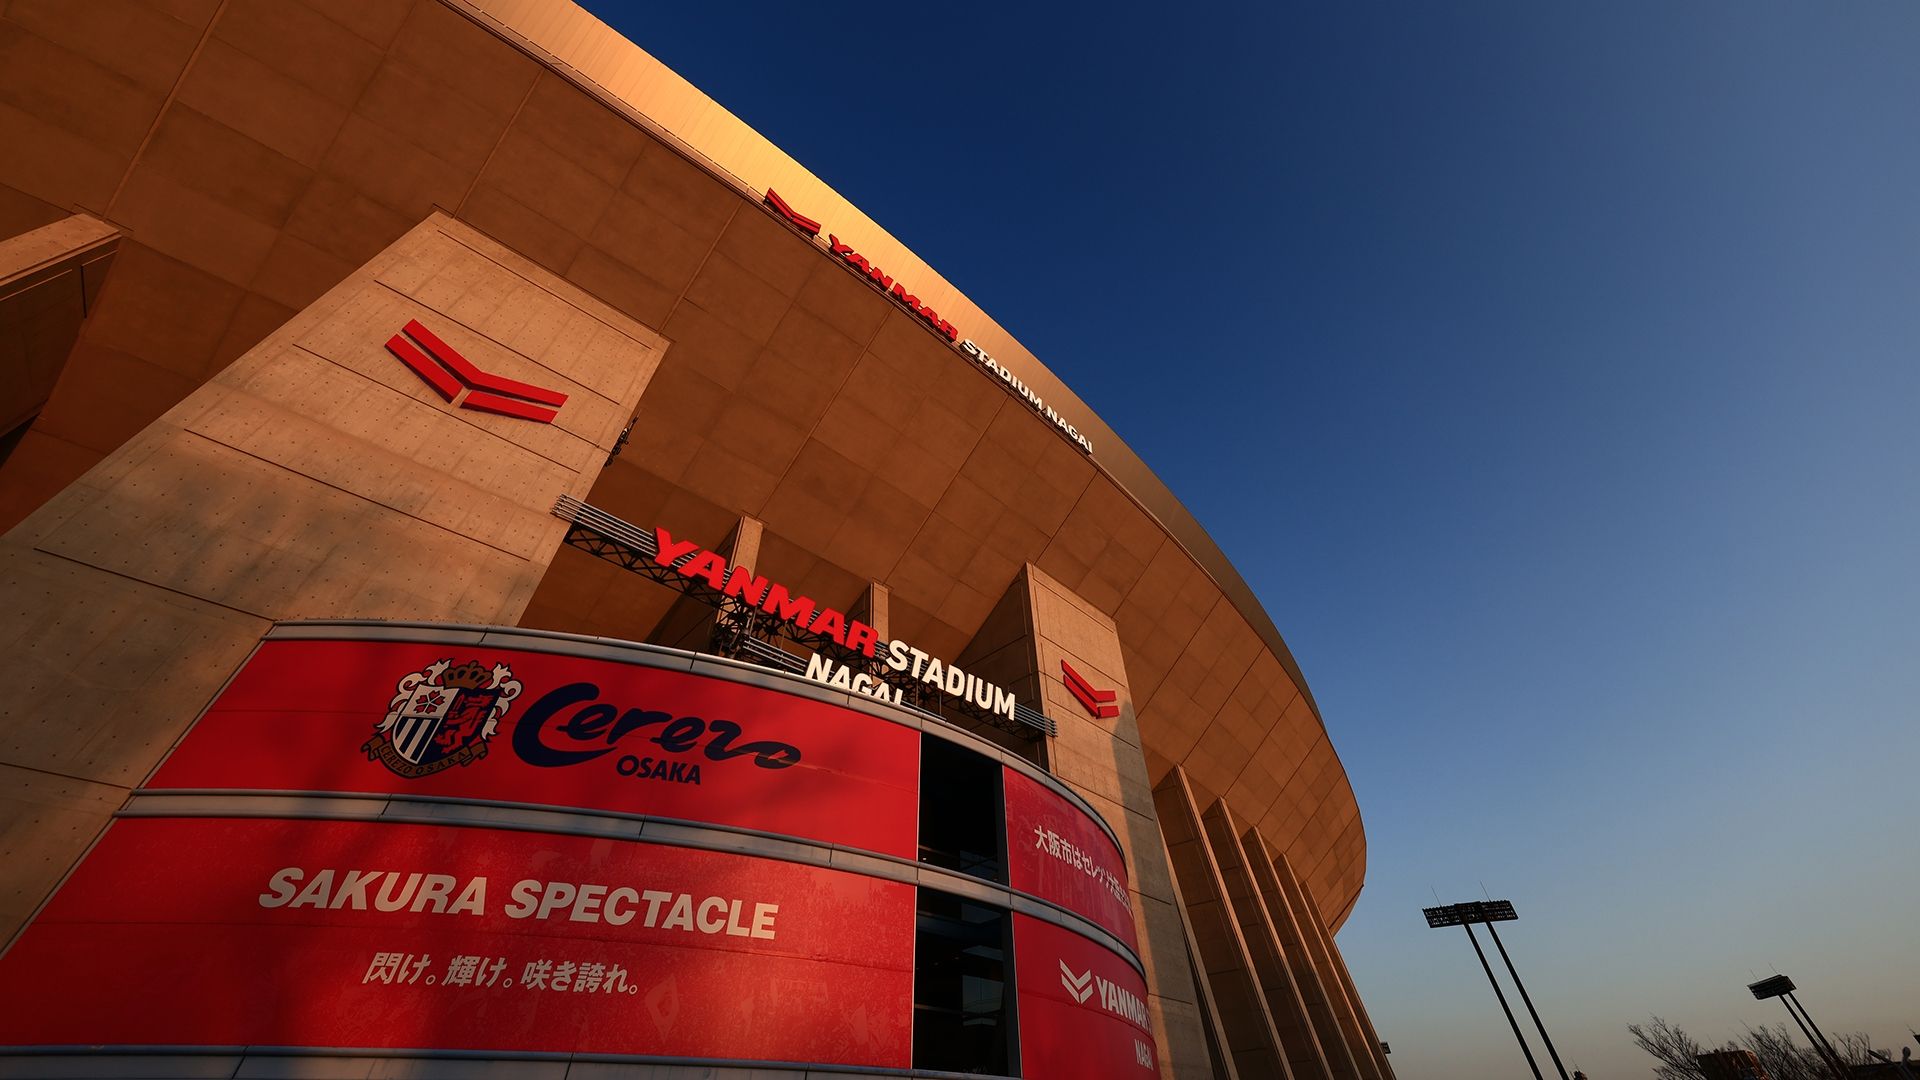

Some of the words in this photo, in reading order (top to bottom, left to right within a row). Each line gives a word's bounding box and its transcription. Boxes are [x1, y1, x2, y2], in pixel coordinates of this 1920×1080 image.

[829, 233, 959, 342] YANMAR
[959, 339, 1046, 413] STADIUM
[1045, 405, 1094, 455] NAGAI
[654, 527, 880, 658] YANMAR
[885, 640, 1017, 721] STADIUM
[804, 653, 904, 706] NAGAI
[512, 682, 802, 768] Cerezo
[381, 745, 412, 775] CEREZO
[415, 751, 466, 775] OSAKA
[616, 755, 701, 785] OSAKA
[258, 867, 488, 916] SAKURA
[504, 879, 779, 940] SPECTACLE
[361, 951, 639, 995] 閃け。輝け。咲き誇れ。
